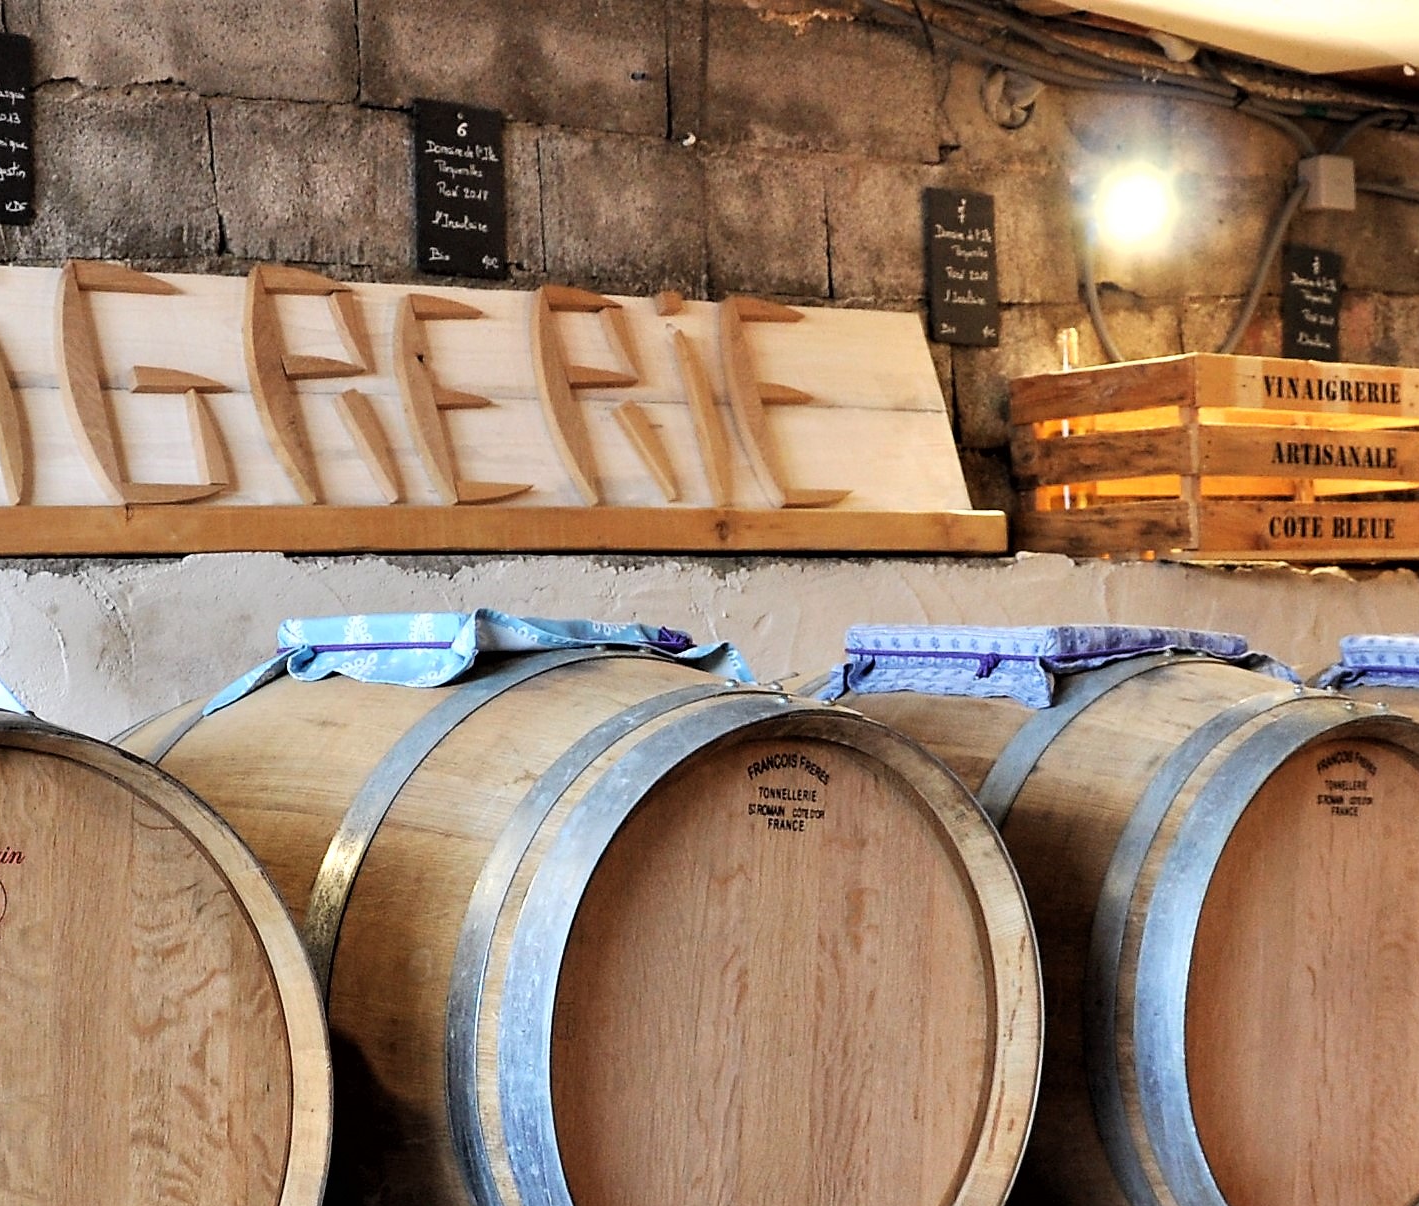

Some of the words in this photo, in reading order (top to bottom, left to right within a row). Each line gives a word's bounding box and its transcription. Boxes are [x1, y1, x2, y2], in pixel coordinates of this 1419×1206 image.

[456, 122, 469, 137] 6
[1264, 375, 1401, 404] VINAIGRERIE
[1272, 441, 1397, 468] ARTISANALE
[1333, 516, 1395, 539] BLEUE
[758, 786, 817, 802] TONNELLERIE
[767, 818, 805, 832] FRANCE
